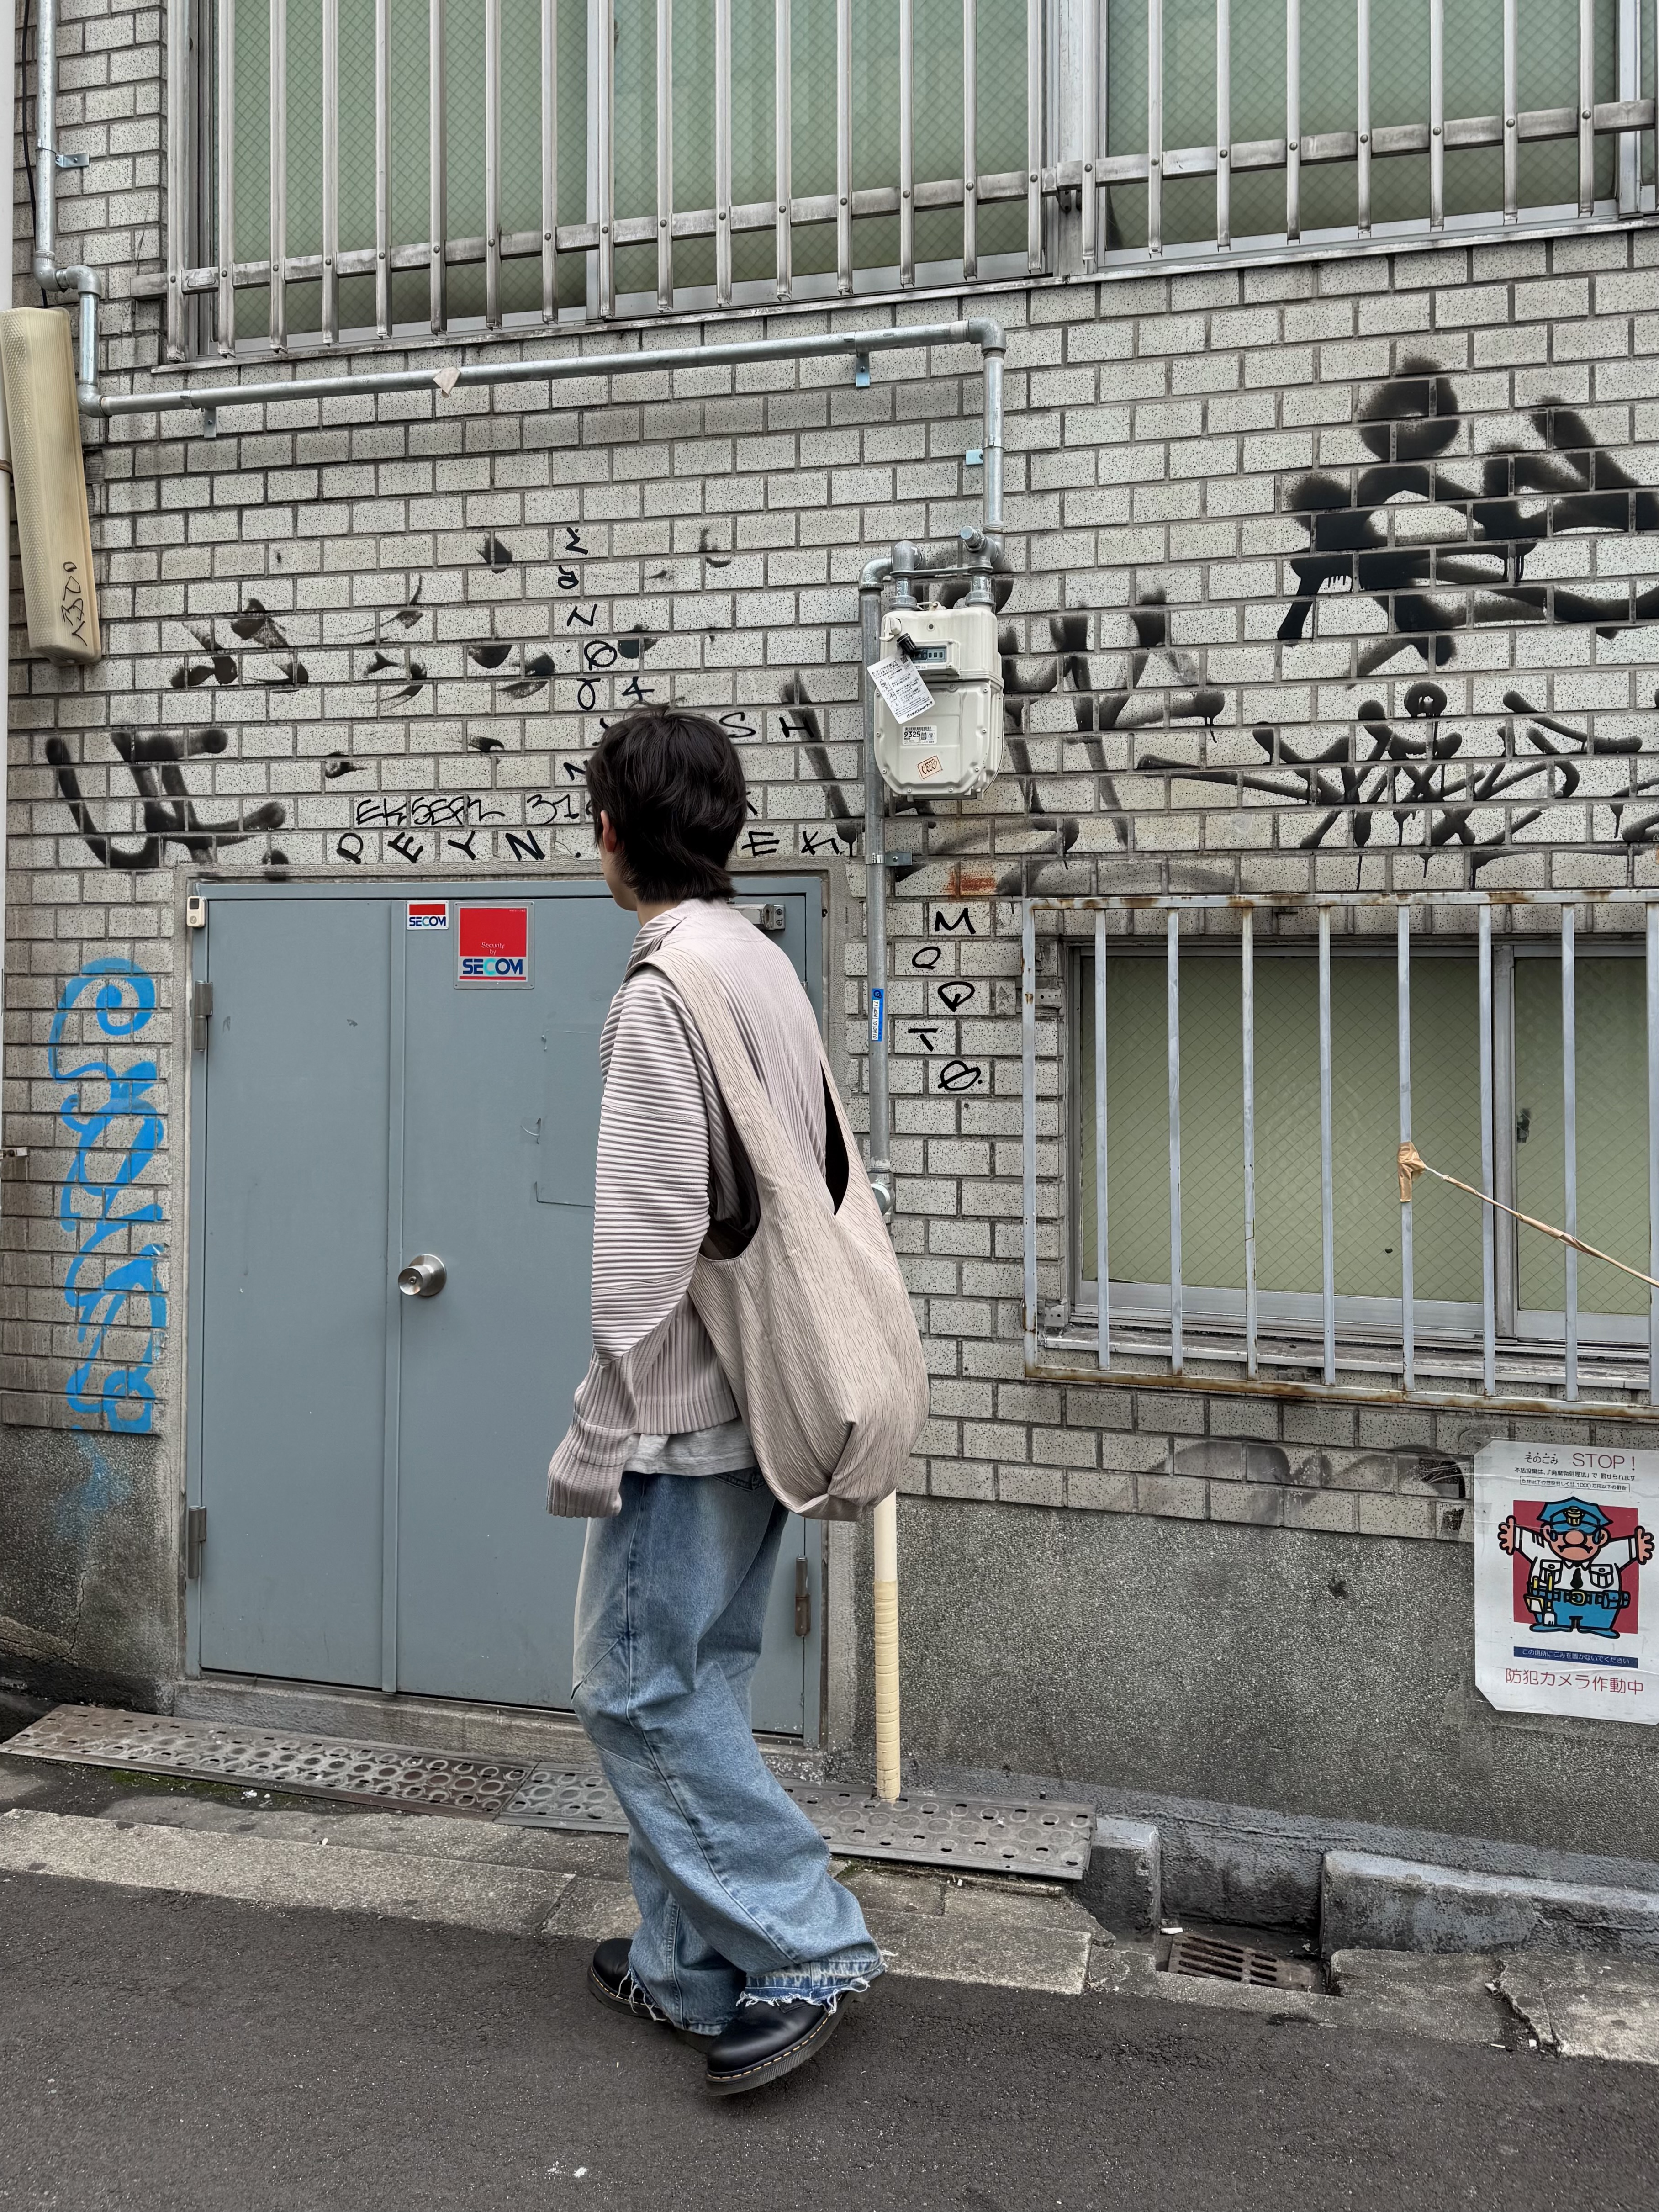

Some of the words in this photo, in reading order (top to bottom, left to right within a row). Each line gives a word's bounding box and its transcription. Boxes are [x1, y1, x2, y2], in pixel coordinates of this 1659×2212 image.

[409, 916, 446, 927] SECOM
[462, 958, 523, 975] SECOM
[1506, 1668, 1643, 1695] 防犯カメラ作動中
